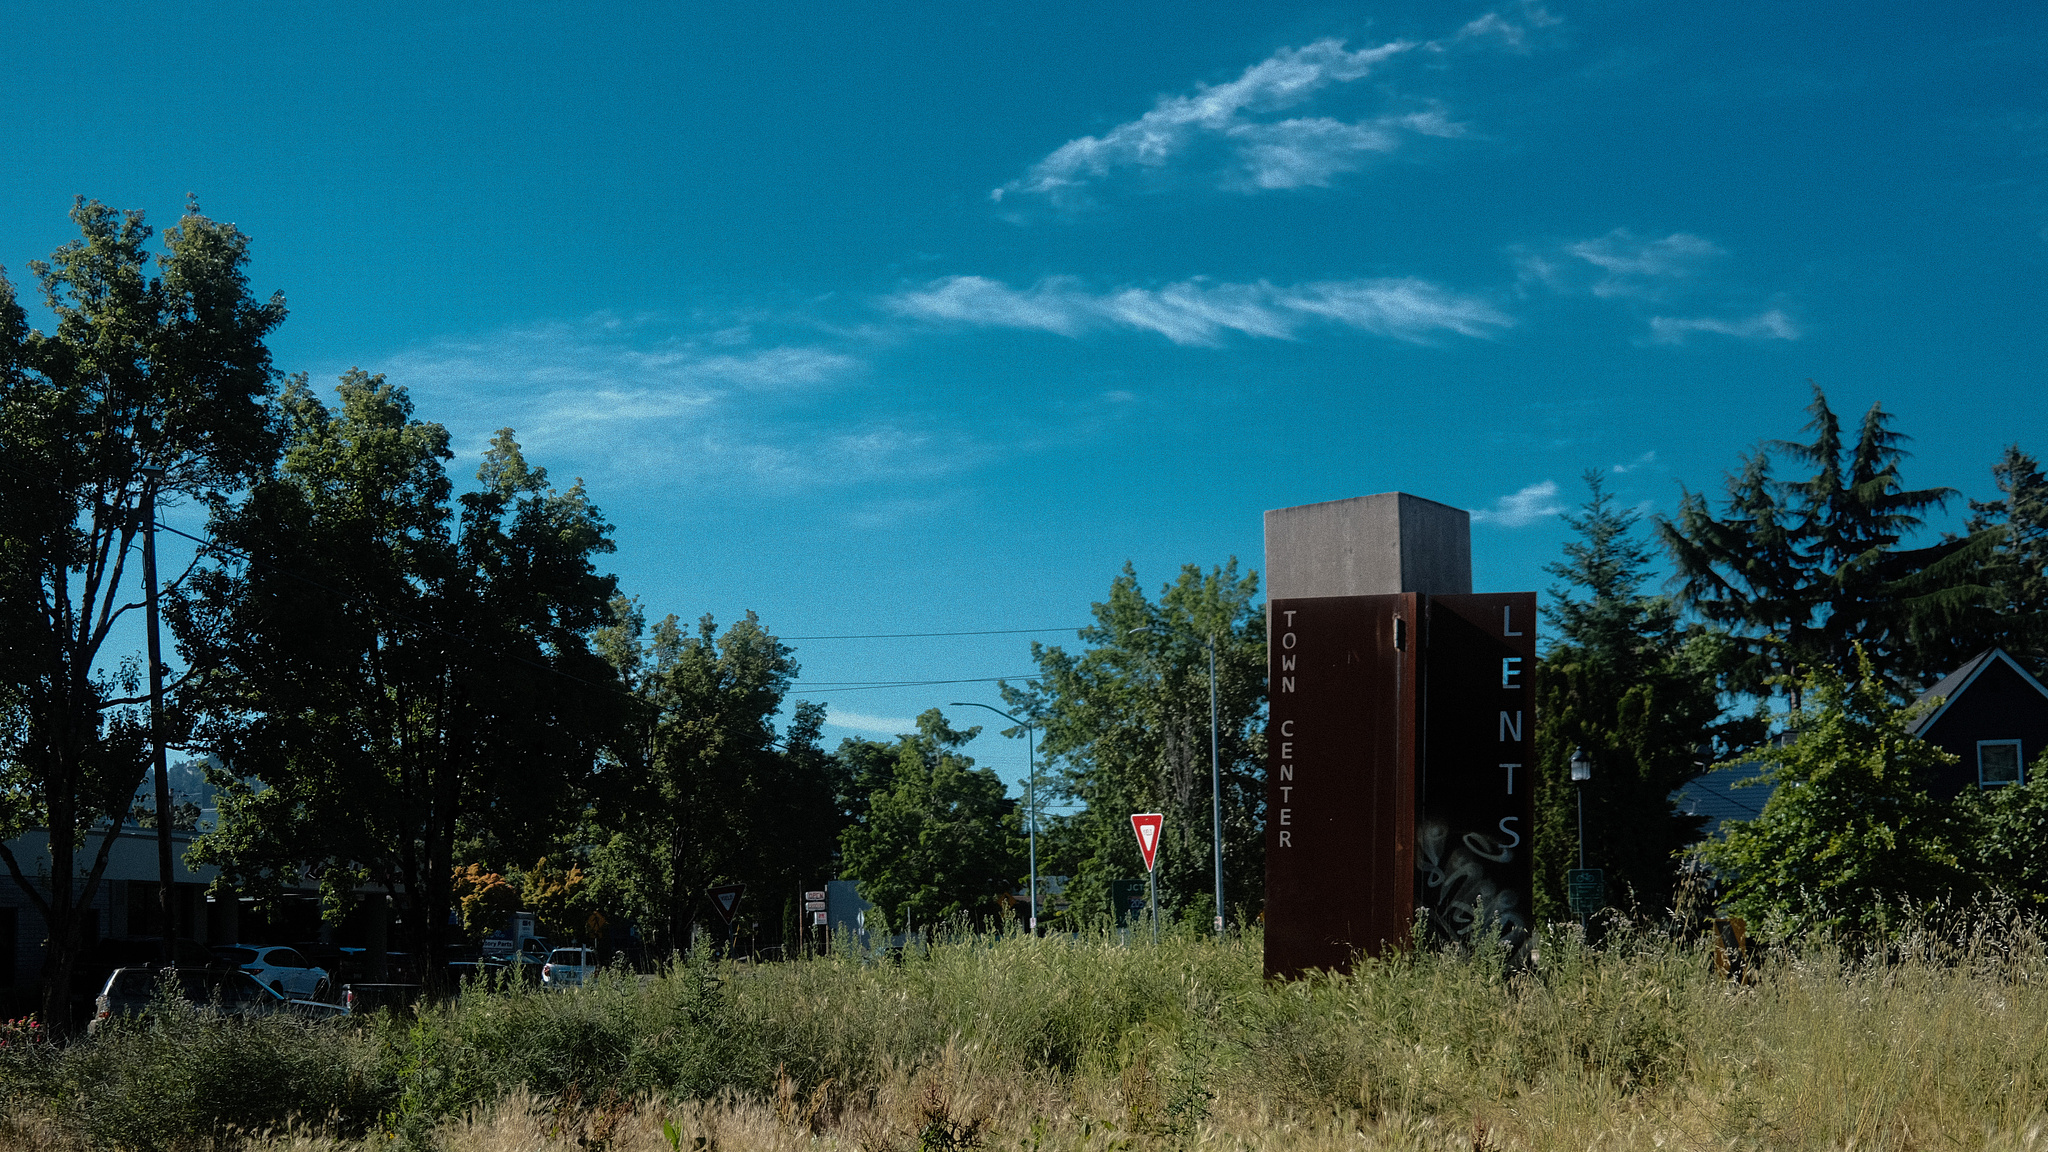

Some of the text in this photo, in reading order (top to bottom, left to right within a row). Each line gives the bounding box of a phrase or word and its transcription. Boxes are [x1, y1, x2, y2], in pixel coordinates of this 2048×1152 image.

[1279, 610, 1297, 848] TOWN CENTER
[1498, 605, 1523, 849] LENTS
[1126, 883, 1144, 892] JCT
[1130, 899, 1144, 908] 205
